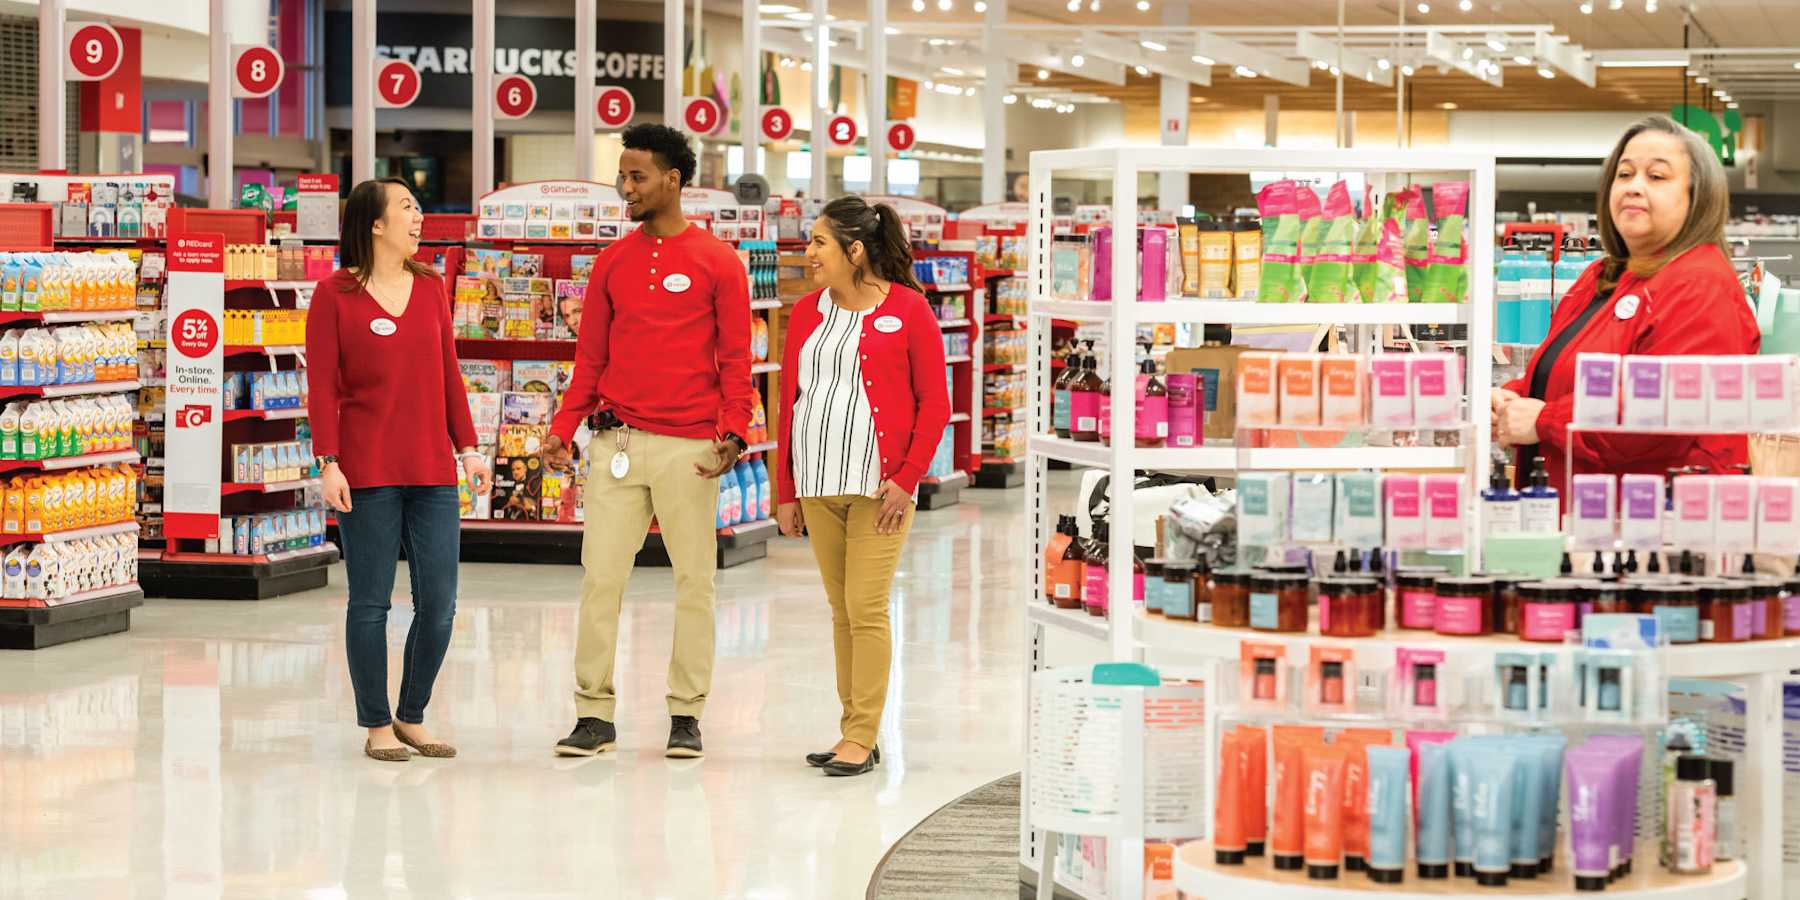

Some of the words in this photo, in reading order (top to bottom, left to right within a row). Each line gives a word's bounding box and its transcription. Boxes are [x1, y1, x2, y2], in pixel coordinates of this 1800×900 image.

[86, 40, 103, 64] 9
[250, 60, 266, 82] 8
[373, 46, 577, 76] TARUCKS
[596, 53, 664, 79] COFFE
[390, 74, 406, 95] 7
[508, 87, 522, 106] 6
[608, 99, 621, 117] 5
[694, 108, 707, 125] 4
[771, 117, 783, 132] 3
[835, 123, 850, 141] 2
[897, 130, 905, 144] 1
[550, 185, 589, 194] GiftCards
[196, 331, 208, 340] off
[175, 366, 215, 375] In-store.
[178, 375, 211, 384] Online.
[170, 384, 196, 394] Every
